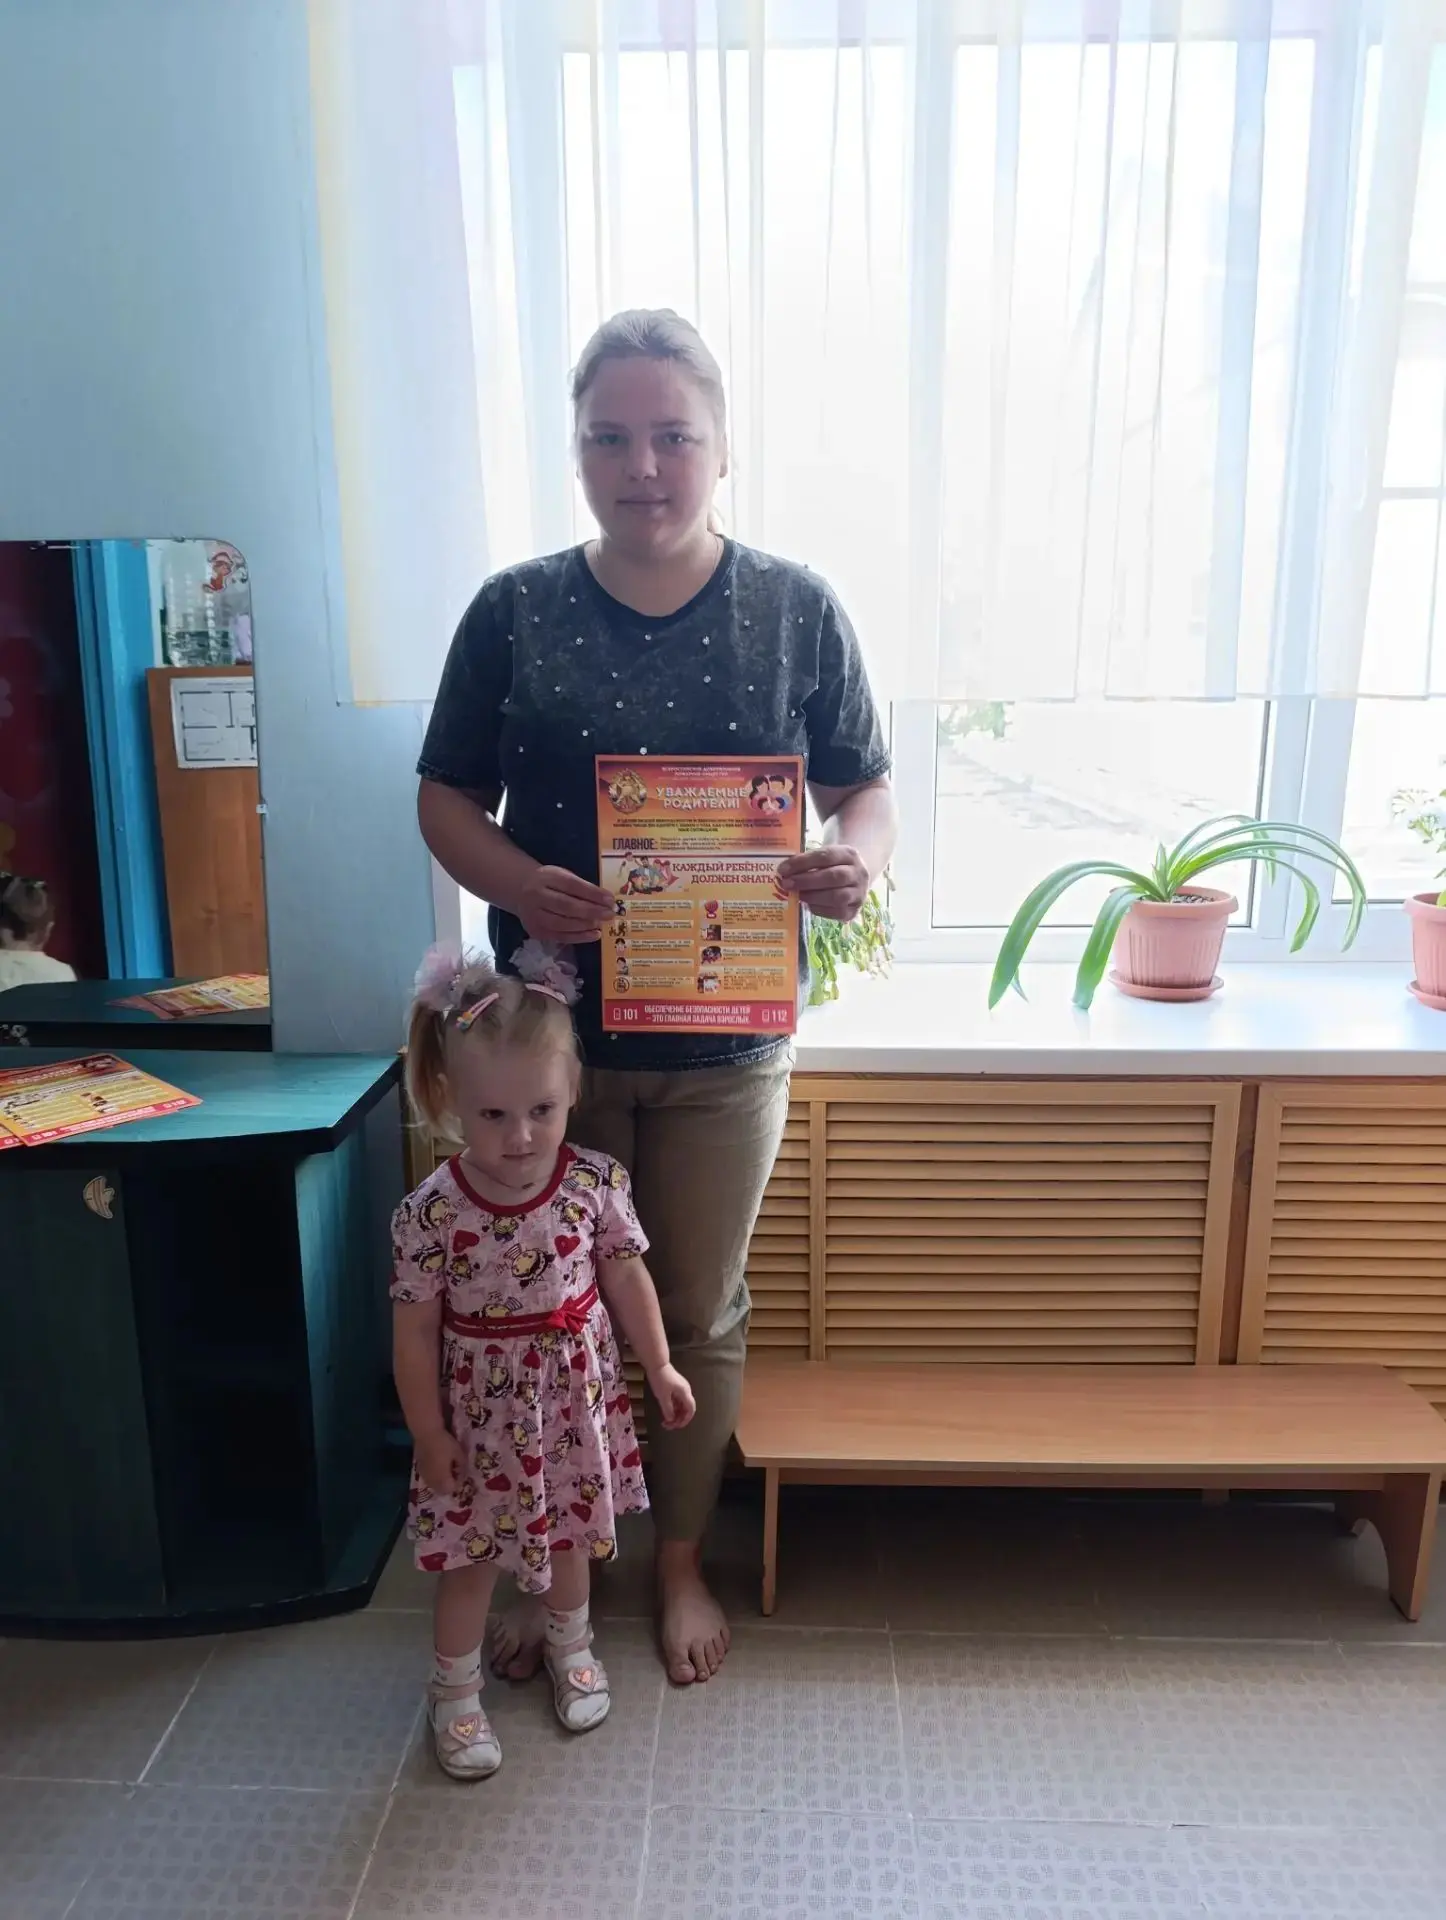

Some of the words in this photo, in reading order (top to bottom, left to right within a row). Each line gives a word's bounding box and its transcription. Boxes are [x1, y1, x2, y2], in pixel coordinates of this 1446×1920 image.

[656, 787, 750, 798] УВАЖАЕМЫЕ
[663, 798, 740, 810] РОДИТЕЛИ!
[612, 837, 658, 850] ГЛАВНОЕ:
[672, 861, 724, 872] КАЖДЫЙ
[725, 861, 774, 872] РЕБЁНОК
[691, 874, 739, 884] ДОЛЖЕН
[623, 1008, 638, 1020] 101
[772, 1010, 787, 1022] 112
